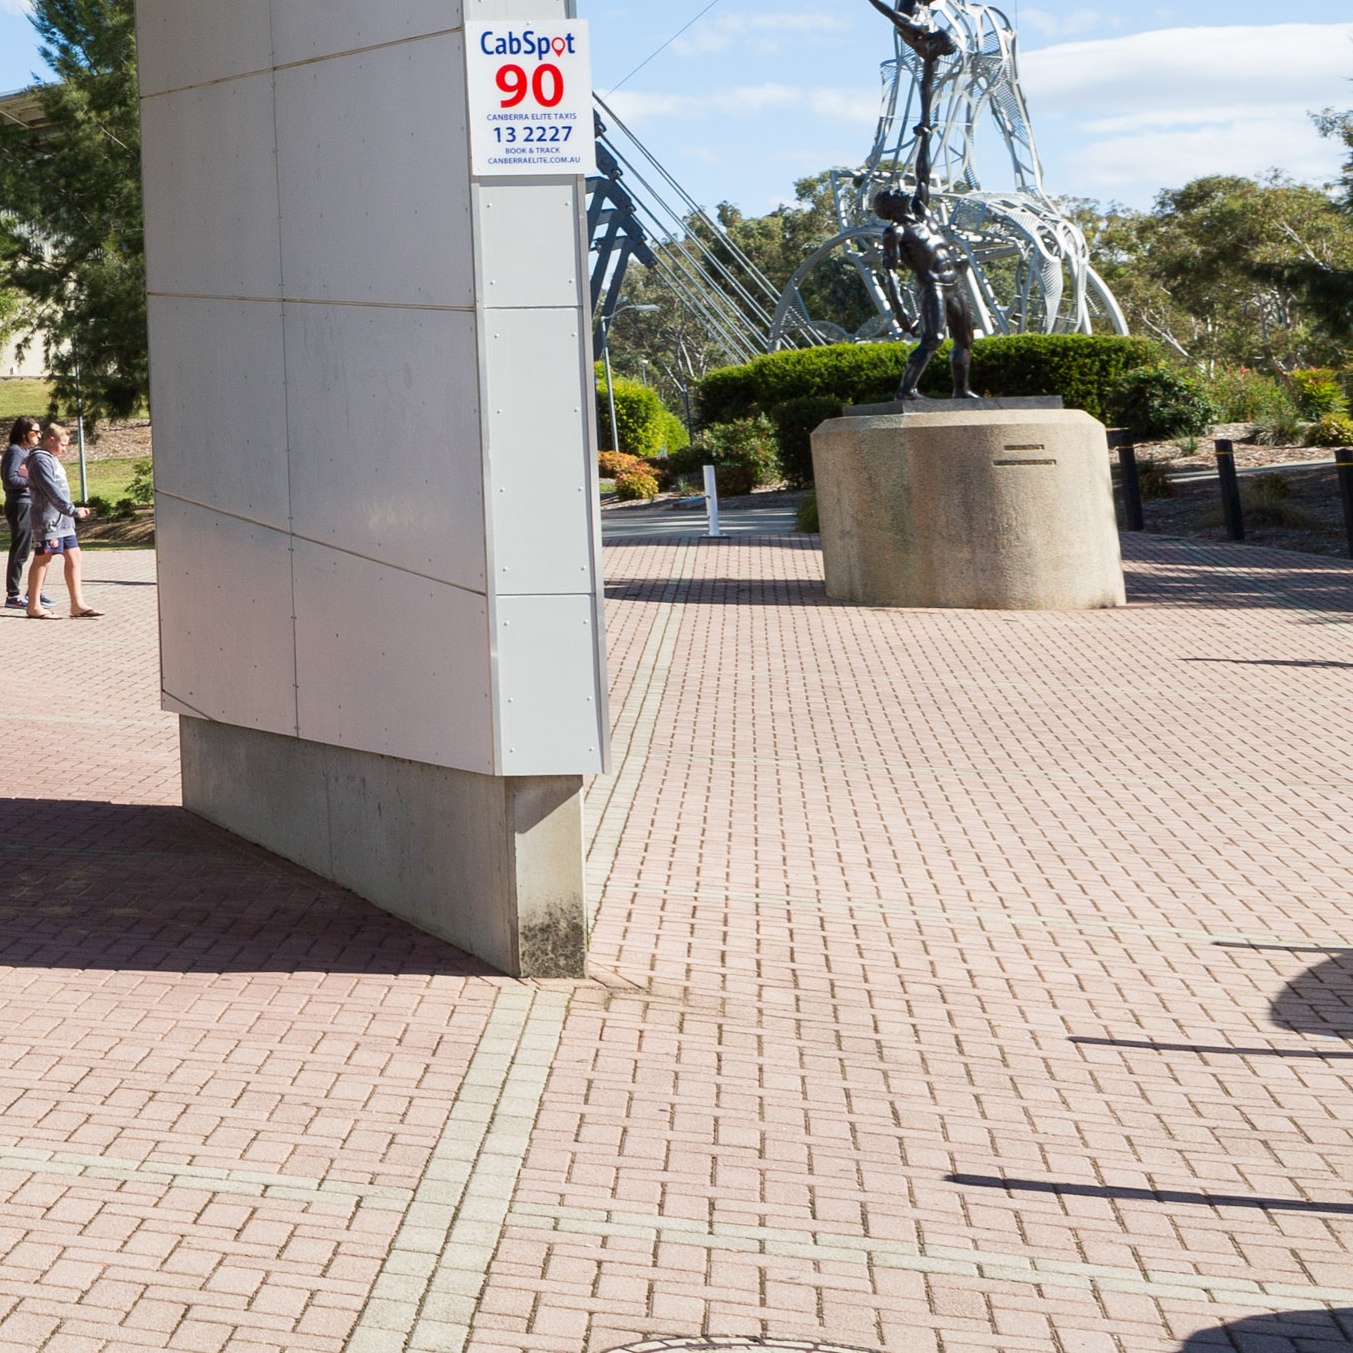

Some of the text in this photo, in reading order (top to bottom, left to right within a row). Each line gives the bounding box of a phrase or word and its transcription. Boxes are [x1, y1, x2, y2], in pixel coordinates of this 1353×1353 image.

[480, 30, 576, 61] CabSpot
[495, 63, 565, 109] 90
[487, 113, 529, 121] CANBERRA
[554, 112, 577, 120] TAXIS
[493, 126, 574, 143] 13 2227
[505, 147, 528, 155] BOOK
[487, 156, 581, 165] CANBERRAELITE.COM.AU
